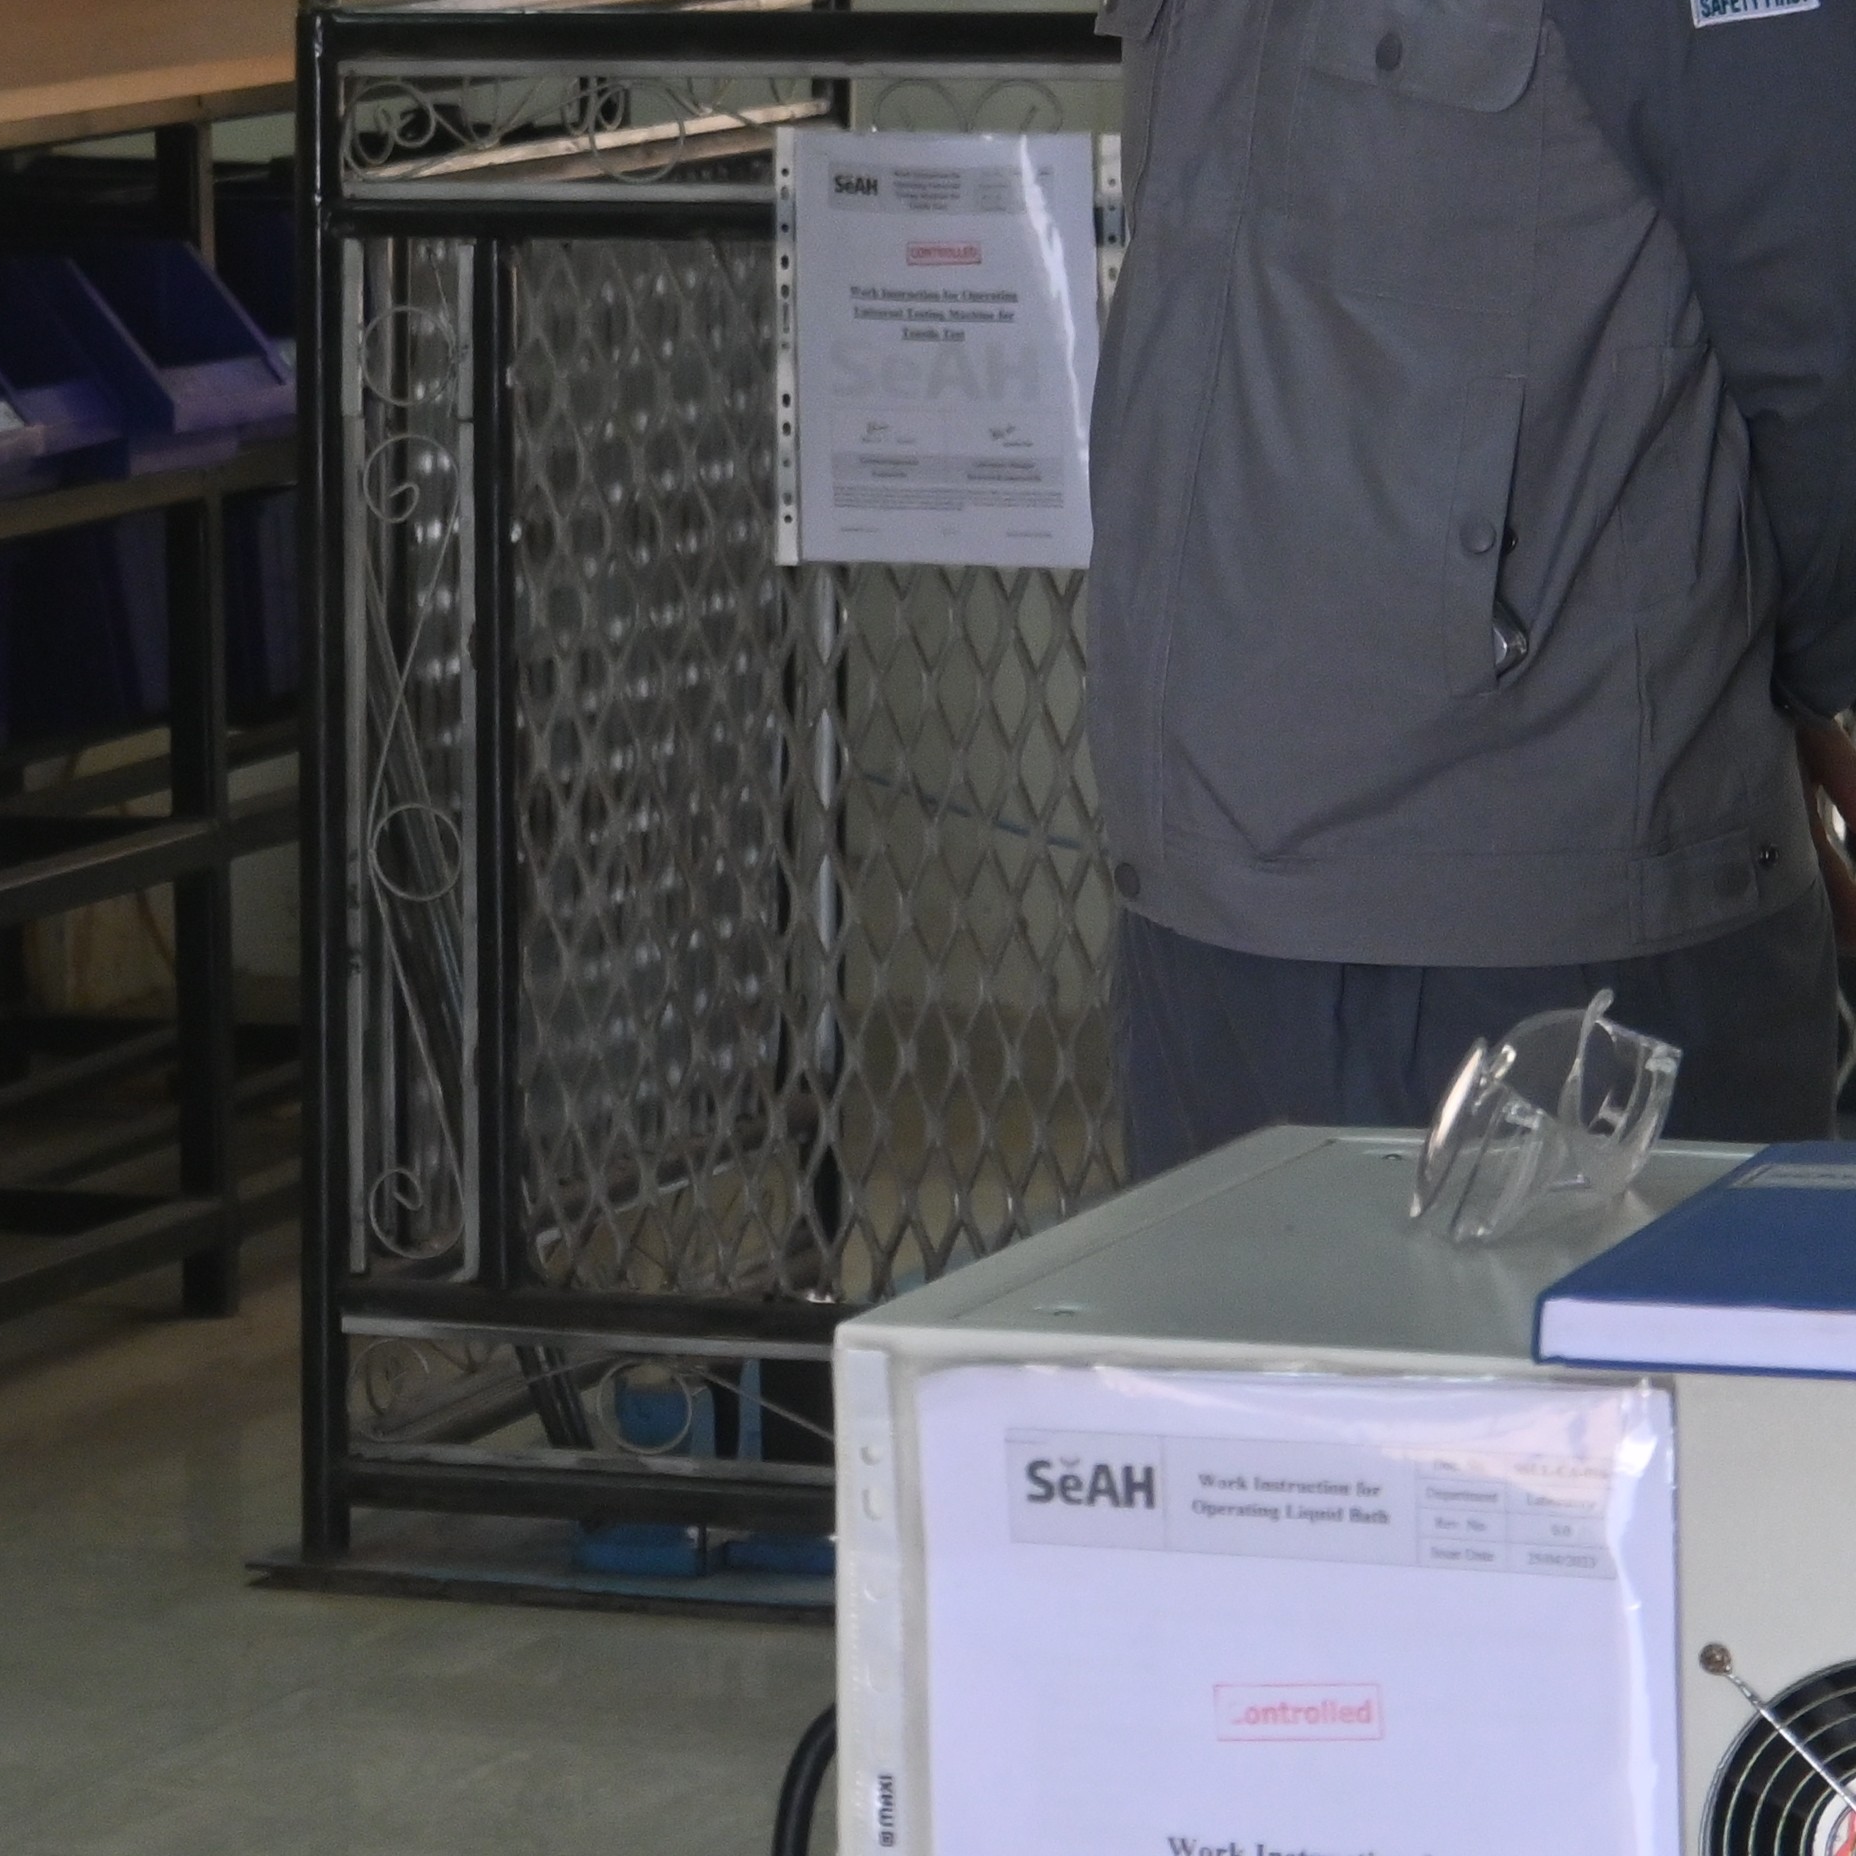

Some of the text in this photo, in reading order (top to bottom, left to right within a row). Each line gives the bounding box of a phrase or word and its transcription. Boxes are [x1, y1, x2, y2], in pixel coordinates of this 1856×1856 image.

[834, 174, 879, 196] SeAH
[1025, 1456, 1156, 1510] SeAH
[1198, 1473, 1381, 1498] Work Instruction for
[1191, 1498, 1281, 1522] Operating
[1286, 1502, 1344, 1525] Liquid
[1232, 1699, 1372, 1726] ontrolled
